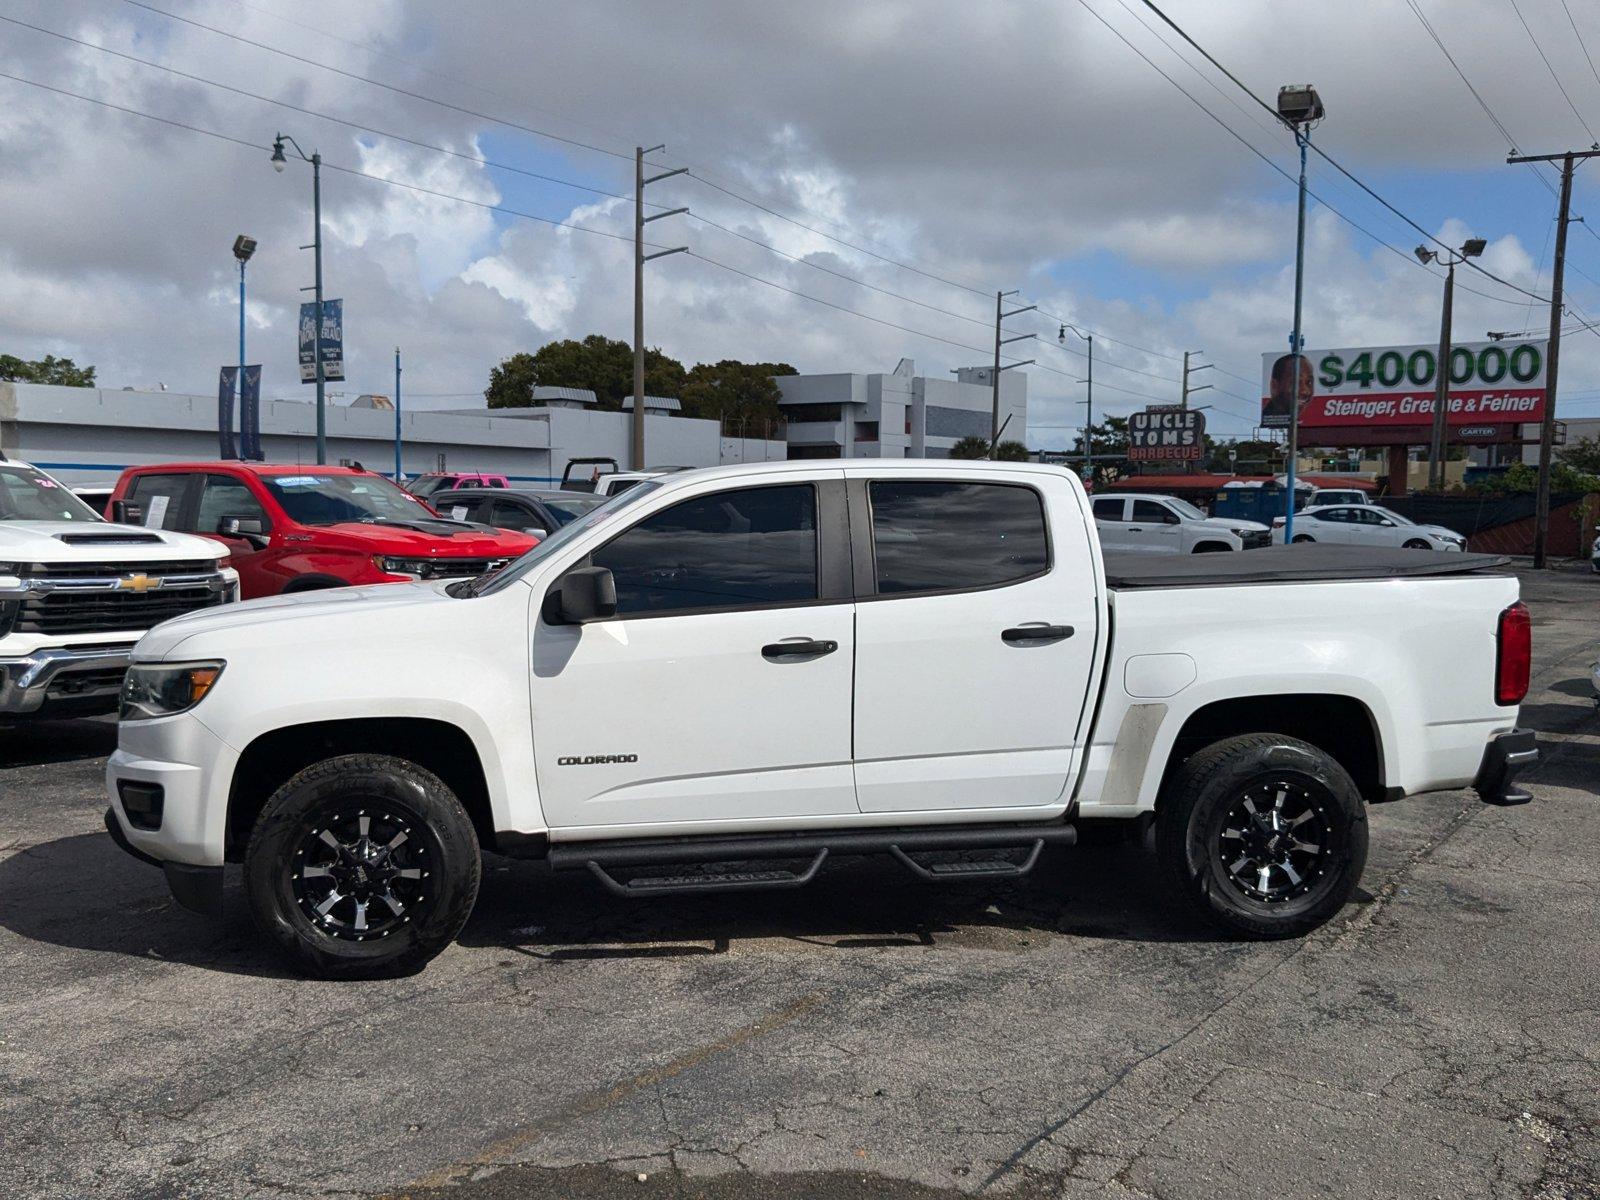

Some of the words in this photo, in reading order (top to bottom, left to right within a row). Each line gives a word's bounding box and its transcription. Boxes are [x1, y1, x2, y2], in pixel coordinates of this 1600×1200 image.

[1318, 344, 1540, 390] $400000
[1323, 398, 1396, 418] Steinger,
[1464, 398, 1476, 412] &
[1479, 394, 1540, 412] Feiner
[1135, 412, 1196, 430] UNCLE
[1130, 447, 1199, 459] BARBECUE
[557, 754, 638, 766] COLORADO
